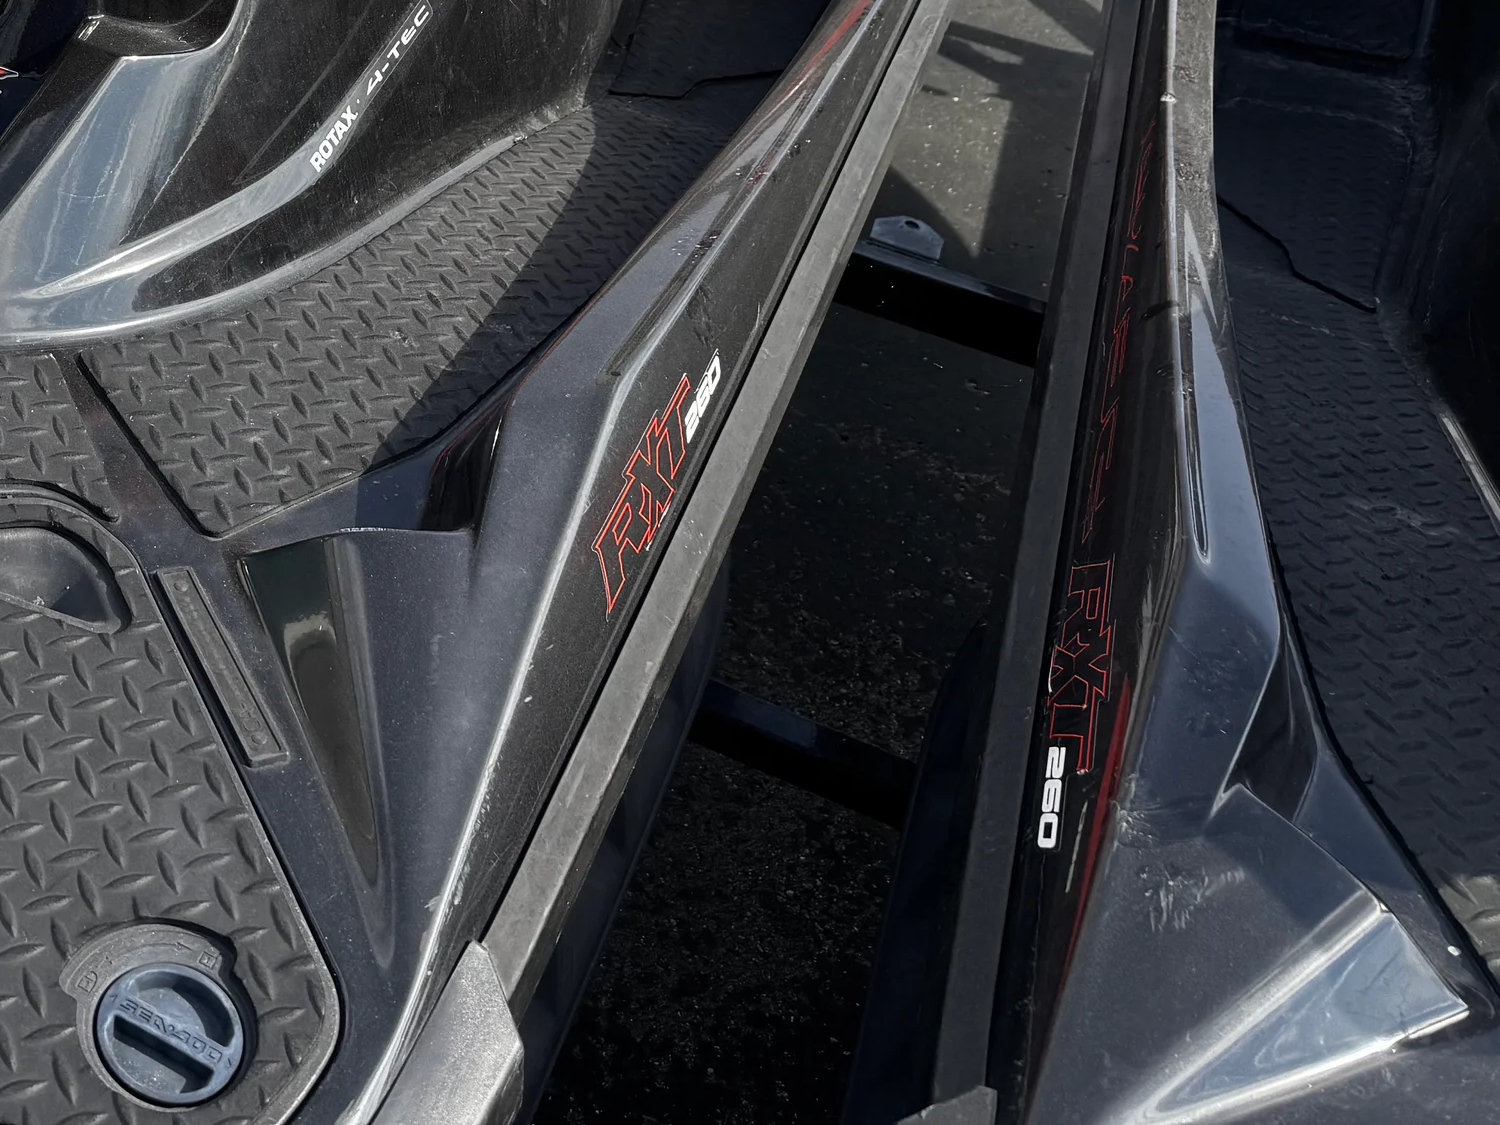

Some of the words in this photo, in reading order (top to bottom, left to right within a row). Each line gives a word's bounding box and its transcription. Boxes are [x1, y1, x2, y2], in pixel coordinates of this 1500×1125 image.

[309, 105, 359, 173] ROTAX
[366, 4, 430, 96] 4-TEC
[686, 354, 722, 444] 260
[1037, 746, 1067, 849] 260
